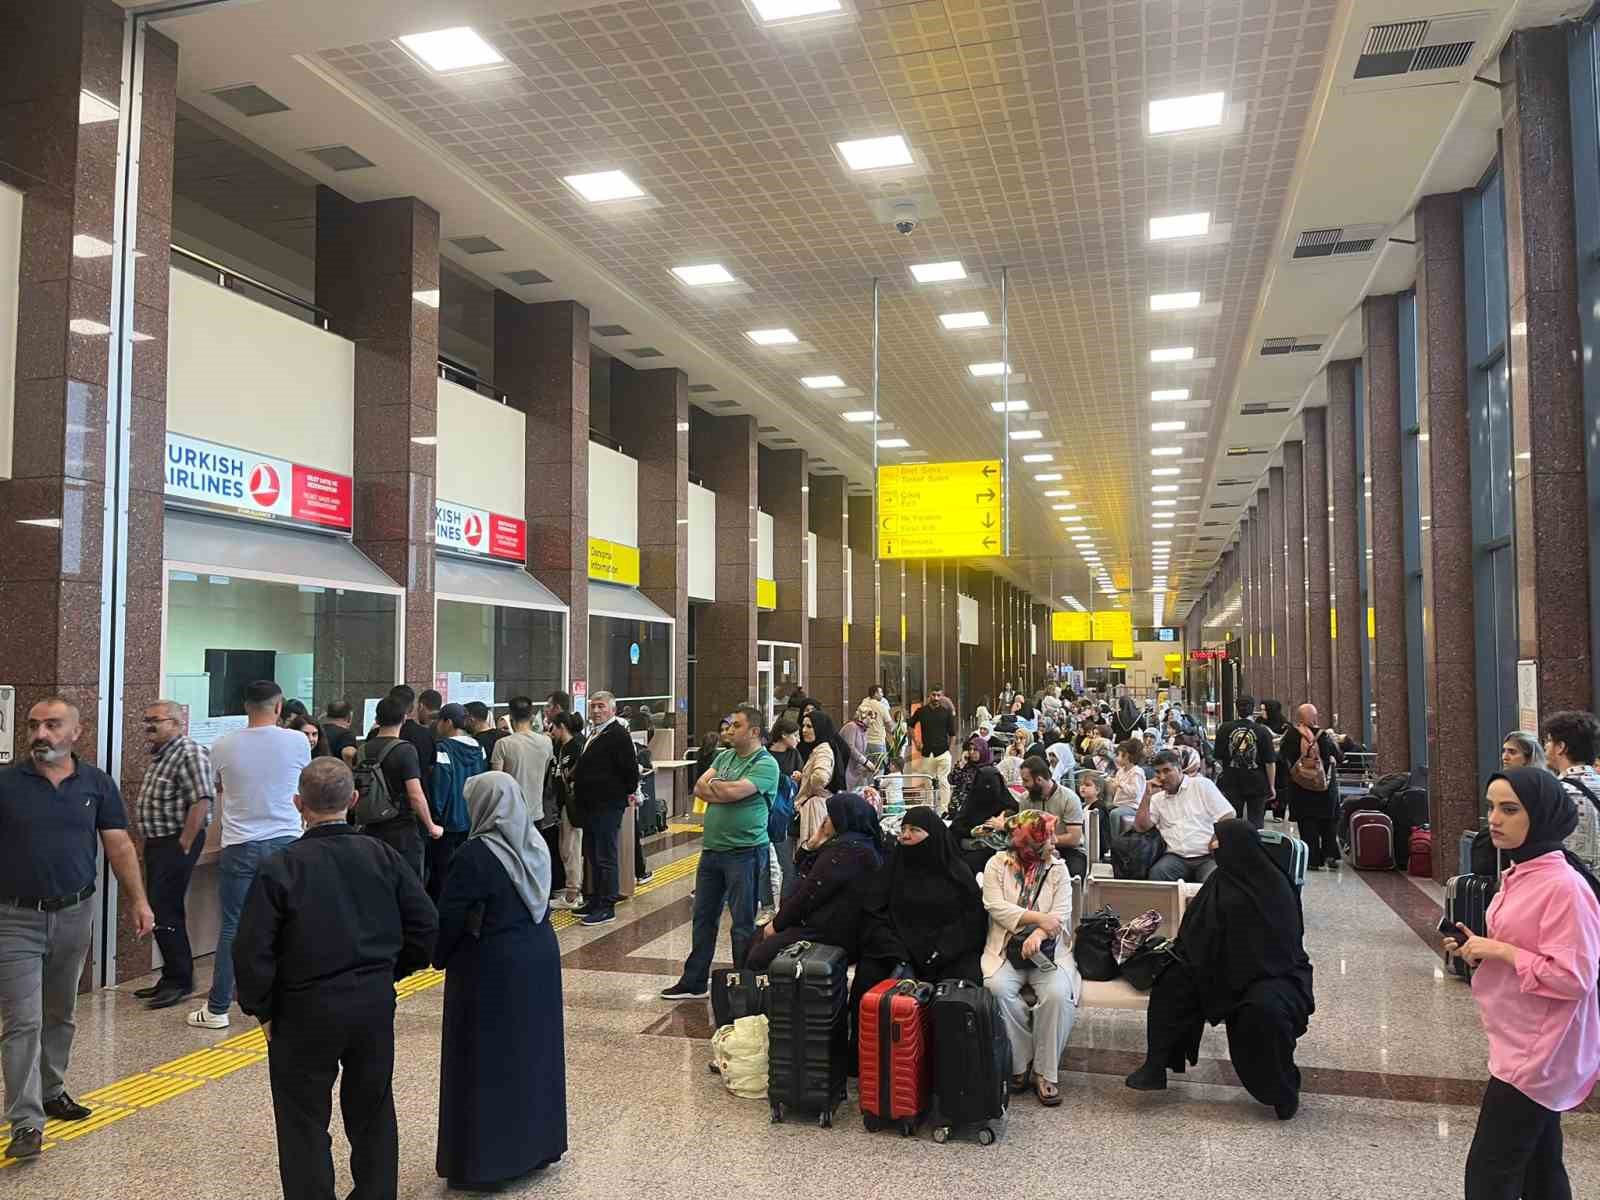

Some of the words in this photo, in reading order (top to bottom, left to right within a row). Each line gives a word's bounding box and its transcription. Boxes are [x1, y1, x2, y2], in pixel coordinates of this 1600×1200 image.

[168, 443, 244, 478] URKISH
[435, 506, 461, 525] KISH
[437, 523, 461, 541] INES
